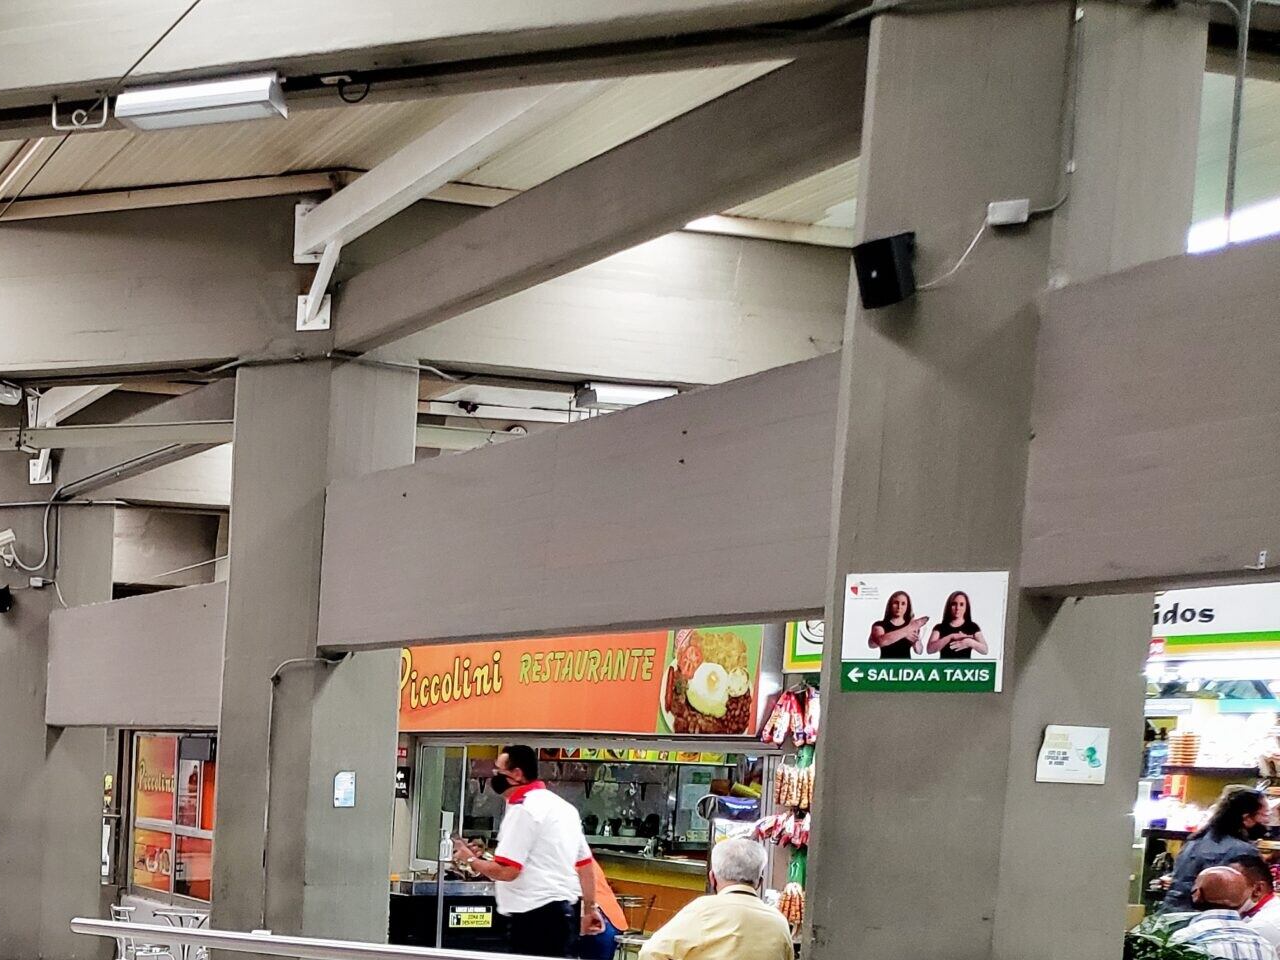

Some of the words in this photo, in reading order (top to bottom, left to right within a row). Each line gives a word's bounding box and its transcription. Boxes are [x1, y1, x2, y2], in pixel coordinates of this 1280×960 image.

[399, 647, 503, 711] Piccolini
[519, 648, 656, 685] RESTAURANTE
[867, 669, 926, 682] SALIDA
[927, 669, 941, 682] A
[943, 669, 990, 682] TAXIS
